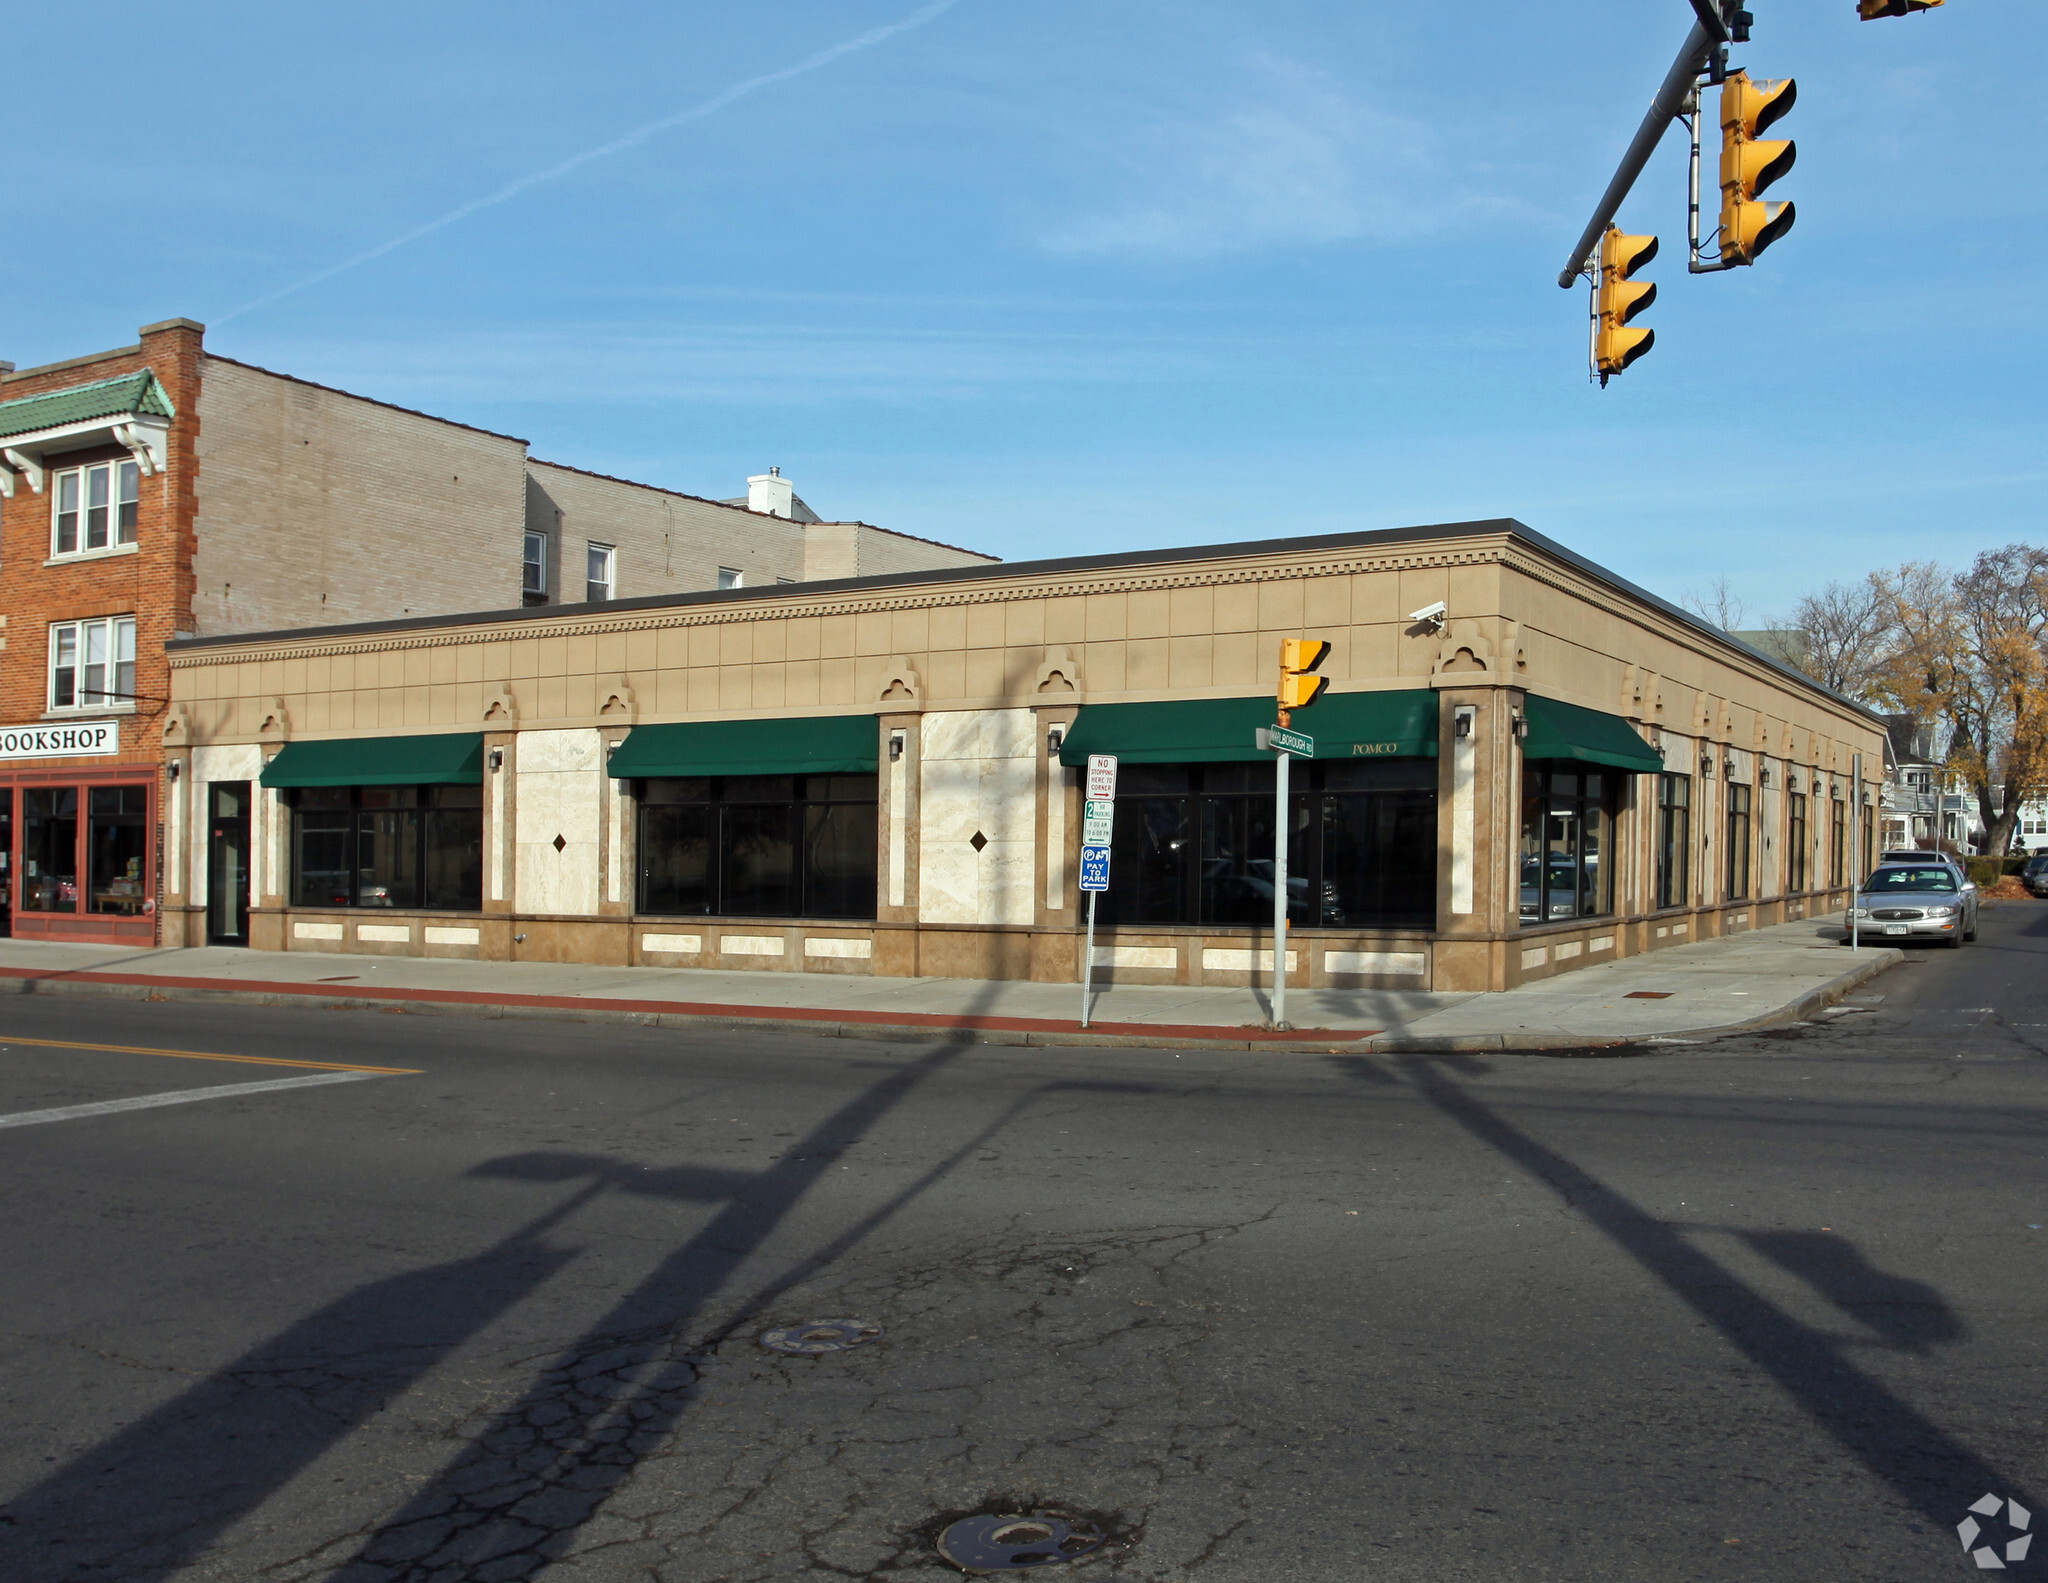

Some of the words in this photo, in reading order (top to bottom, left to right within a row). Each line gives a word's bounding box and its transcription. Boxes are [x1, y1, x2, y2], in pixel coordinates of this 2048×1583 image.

[0, 729, 107, 752] OOKSHOP
[1272, 731, 1306, 751] MARLBOROUGH
[1306, 743, 1312, 753] RD
[1352, 743, 1397, 755] POMCO
[1098, 759, 1109, 768] NO
[1087, 803, 1094, 817] 2
